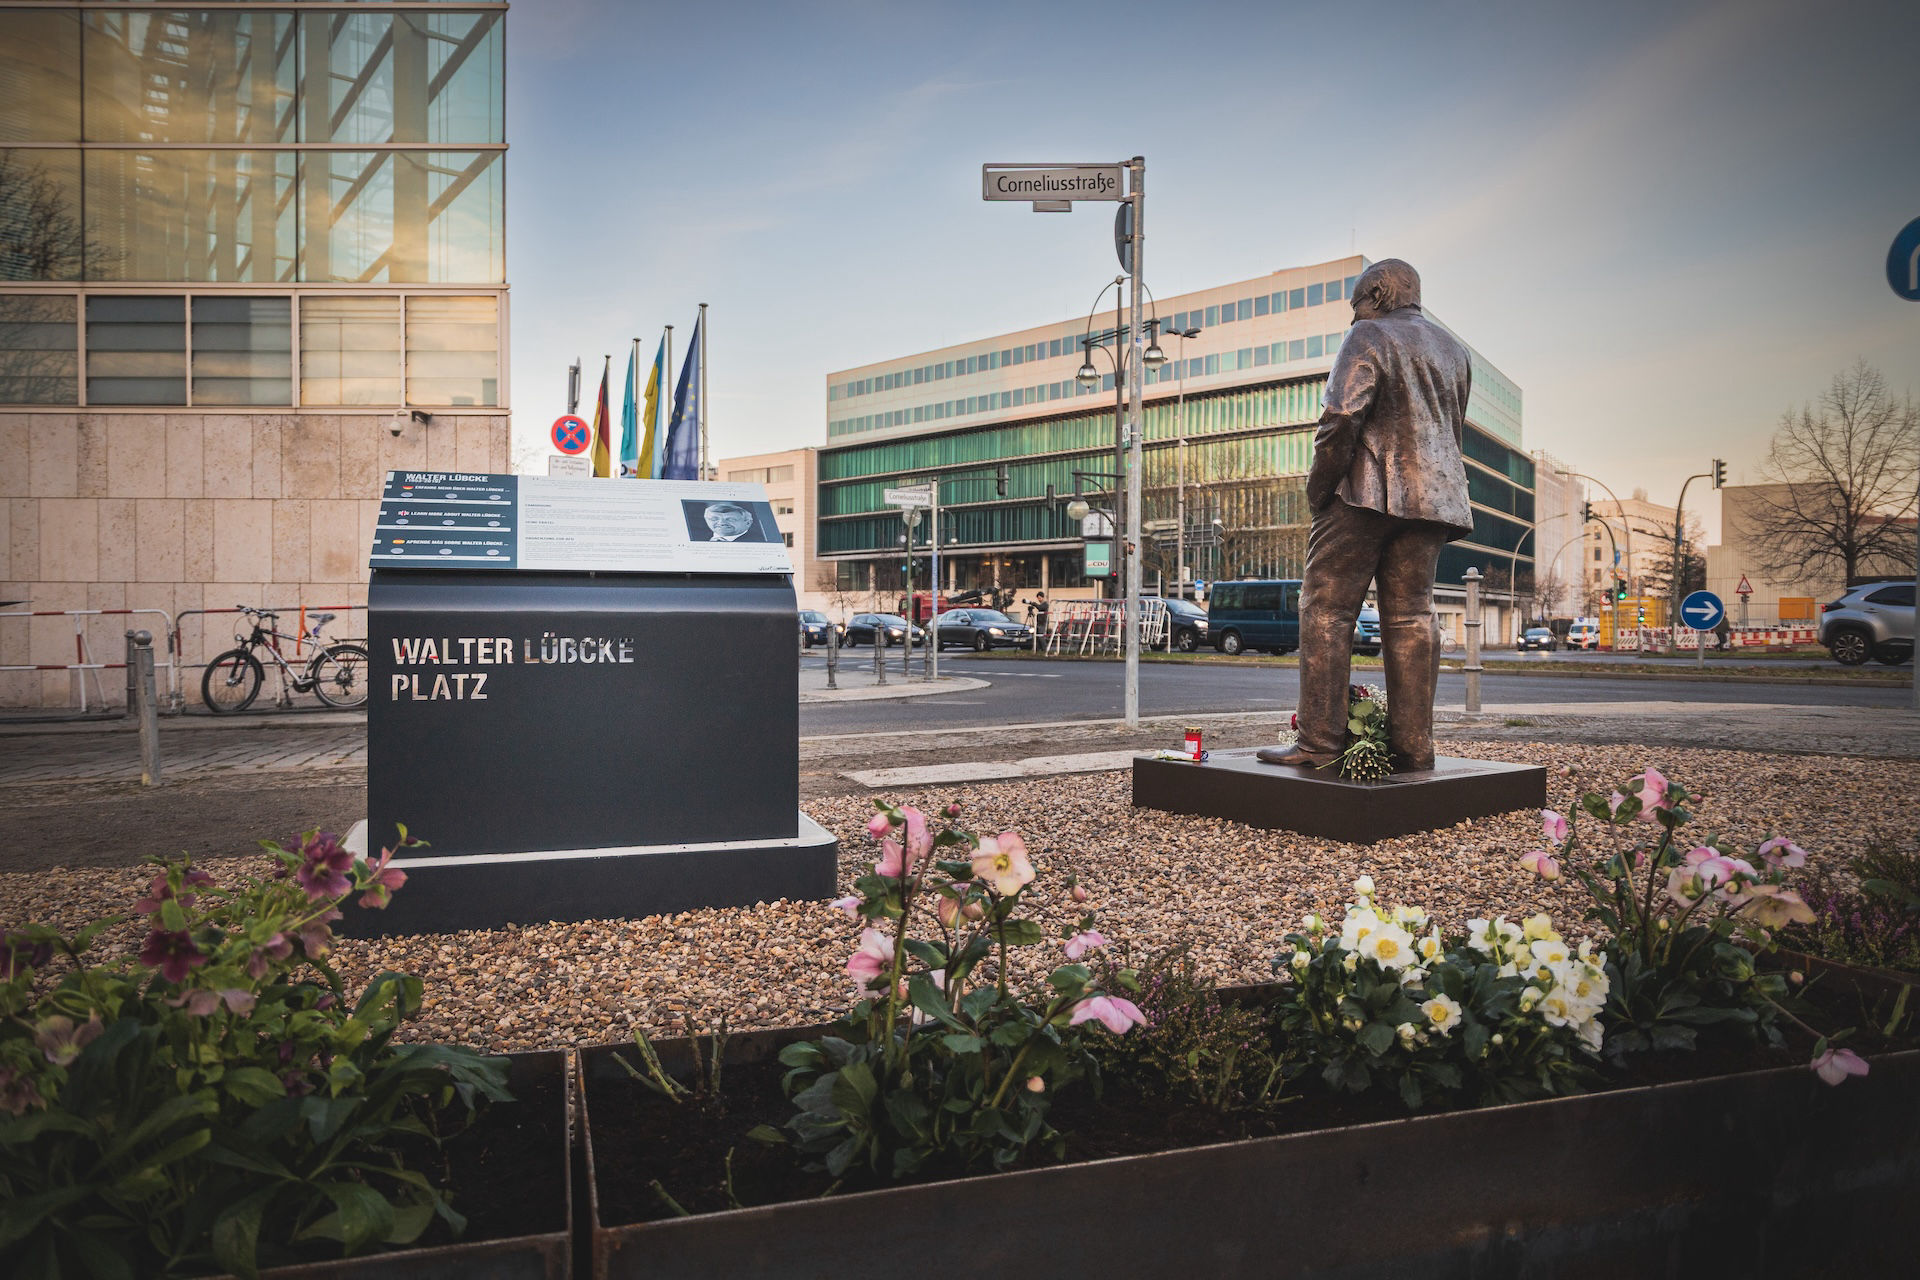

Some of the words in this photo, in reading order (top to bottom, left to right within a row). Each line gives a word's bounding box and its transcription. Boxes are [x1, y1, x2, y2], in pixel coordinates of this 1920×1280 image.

[997, 173, 1115, 193] Corneliusstraße
[405, 473, 446, 481] WALTER
[449, 474, 488, 482] LÜBCKE
[392, 637, 514, 665] WALTER
[524, 631, 635, 665] LÜBCKE
[391, 673, 488, 701] PLATZ
